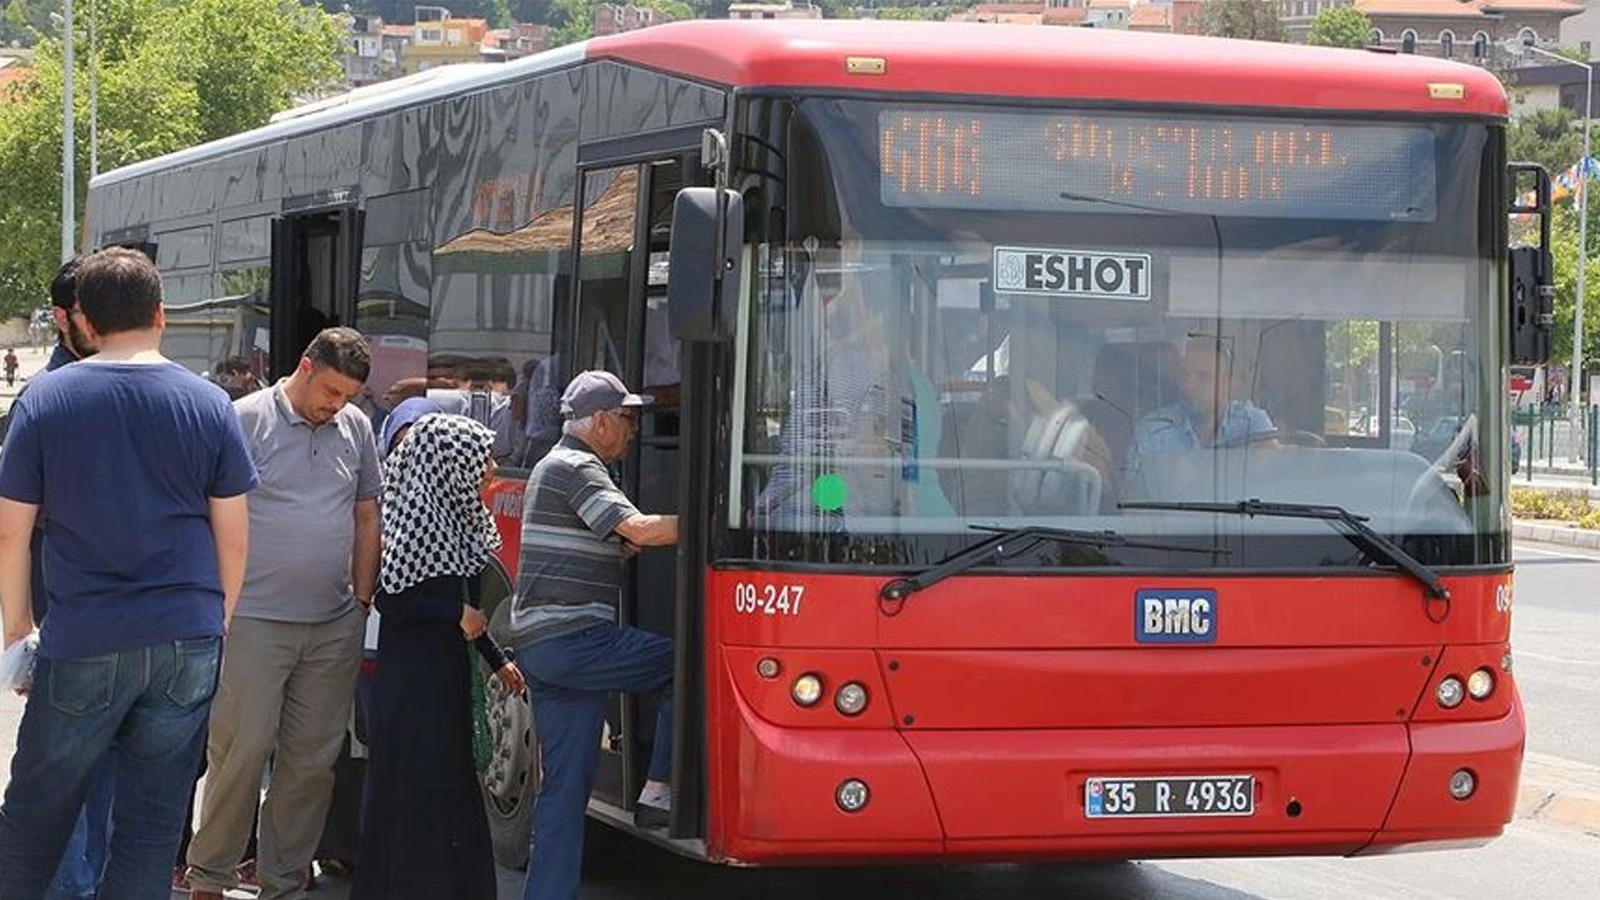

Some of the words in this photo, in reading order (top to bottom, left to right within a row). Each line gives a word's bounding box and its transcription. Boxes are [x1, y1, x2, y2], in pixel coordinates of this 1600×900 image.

[1025, 254, 1144, 294] ESHOT
[735, 582, 804, 615] 09-247
[1144, 598, 1210, 635] BMC
[1105, 783, 1136, 812] 35
[1156, 782, 1170, 811] R
[1185, 781, 1247, 811] 4936
